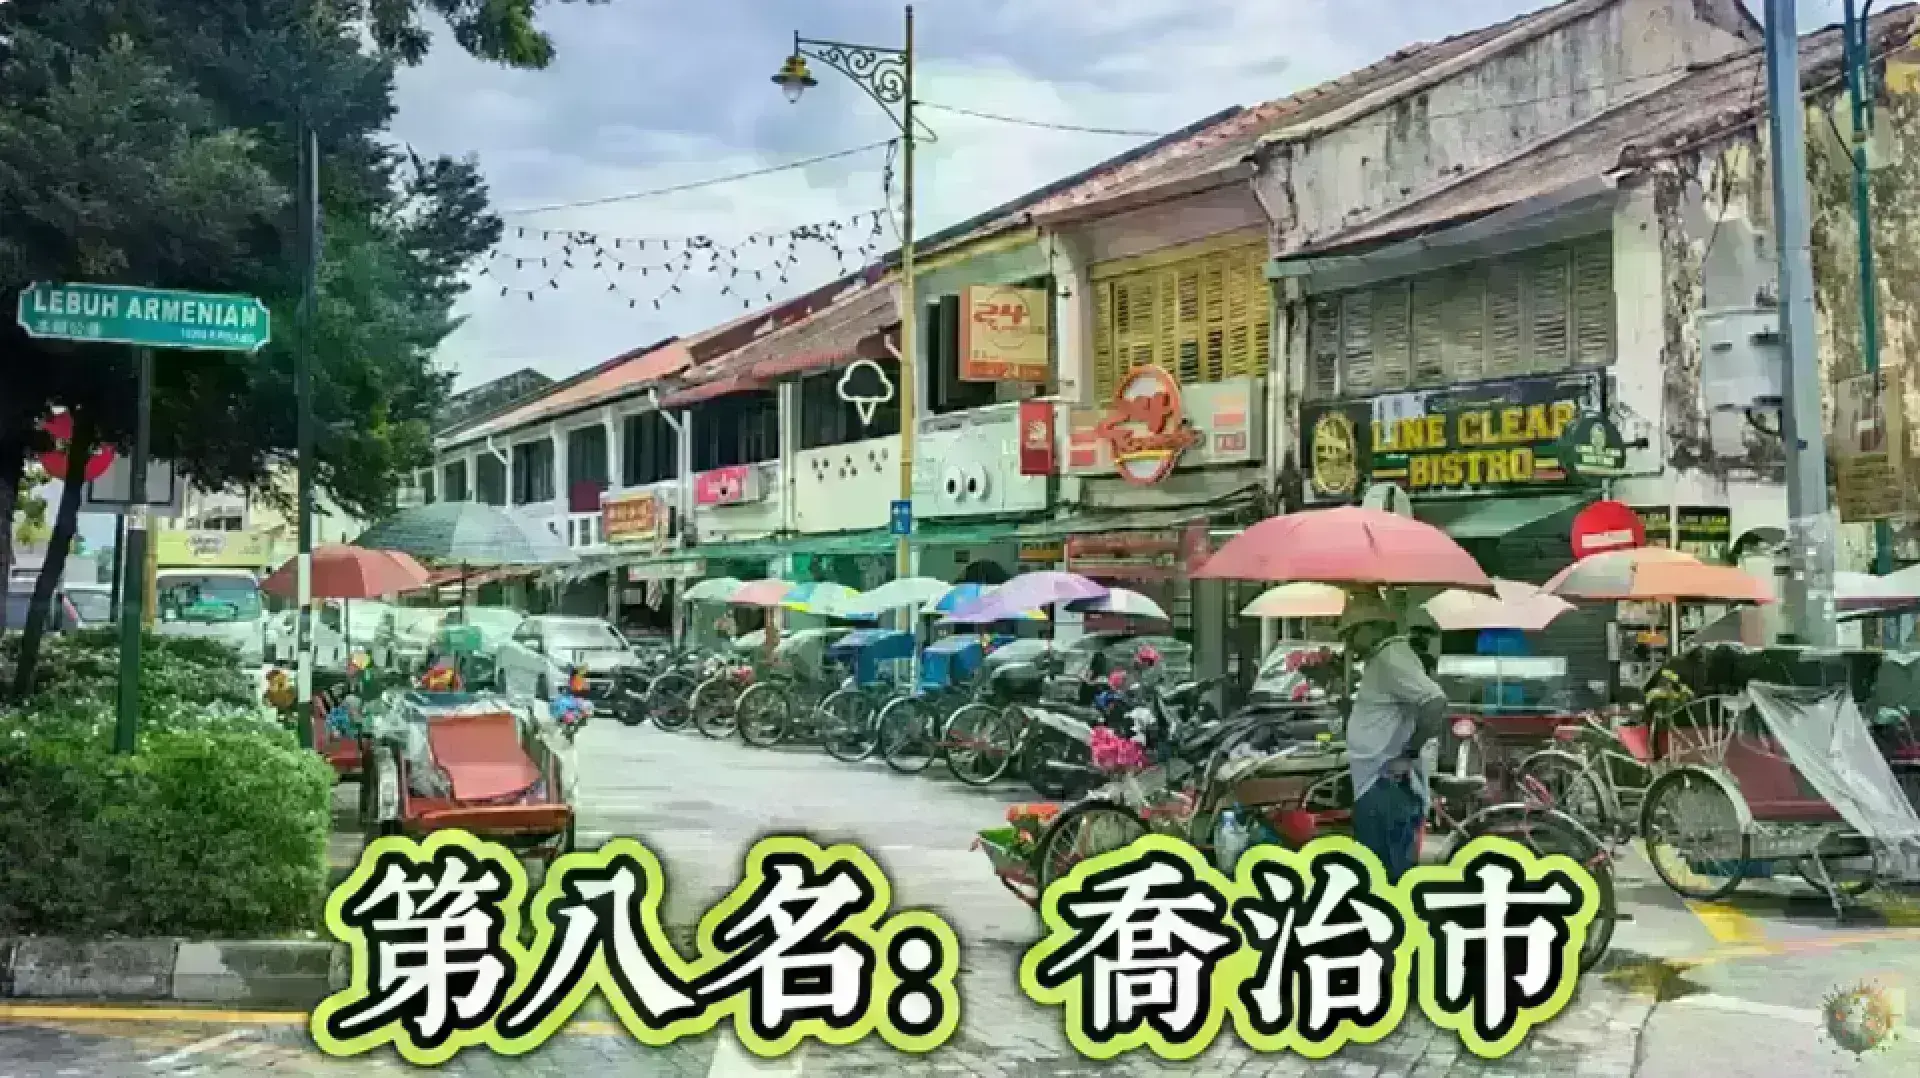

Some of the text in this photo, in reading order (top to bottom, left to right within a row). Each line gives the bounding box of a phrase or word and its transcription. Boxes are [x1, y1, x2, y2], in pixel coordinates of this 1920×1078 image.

[33, 289, 119, 318] LEBUH
[125, 295, 258, 329] ARMENIAN
[1371, 414, 1447, 454] LINE
[1409, 446, 1534, 487] BISTRO
